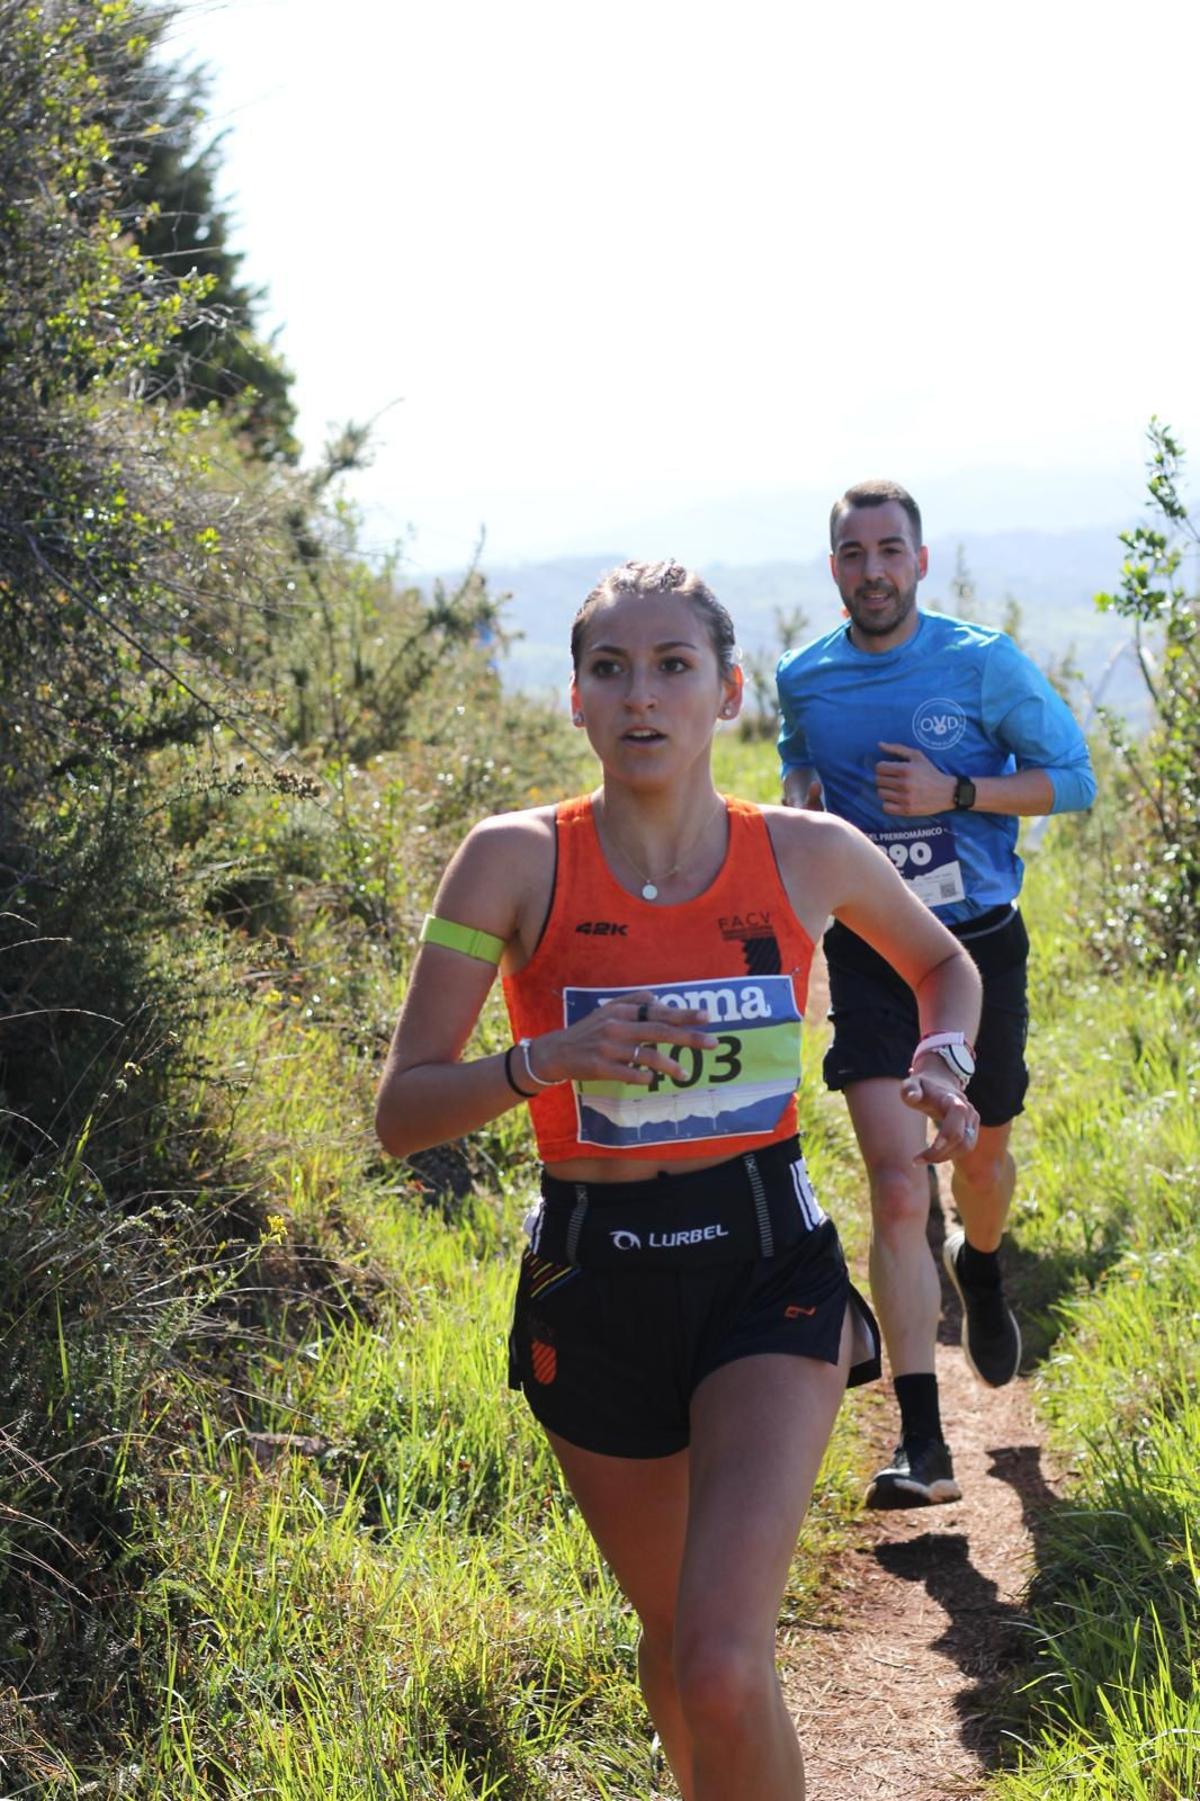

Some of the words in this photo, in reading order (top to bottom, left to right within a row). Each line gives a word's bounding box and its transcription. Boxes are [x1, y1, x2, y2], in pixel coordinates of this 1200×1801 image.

[877, 841, 933, 868] 90
[575, 922, 629, 937] 42K
[648, 1223, 729, 1248] LURBEL
